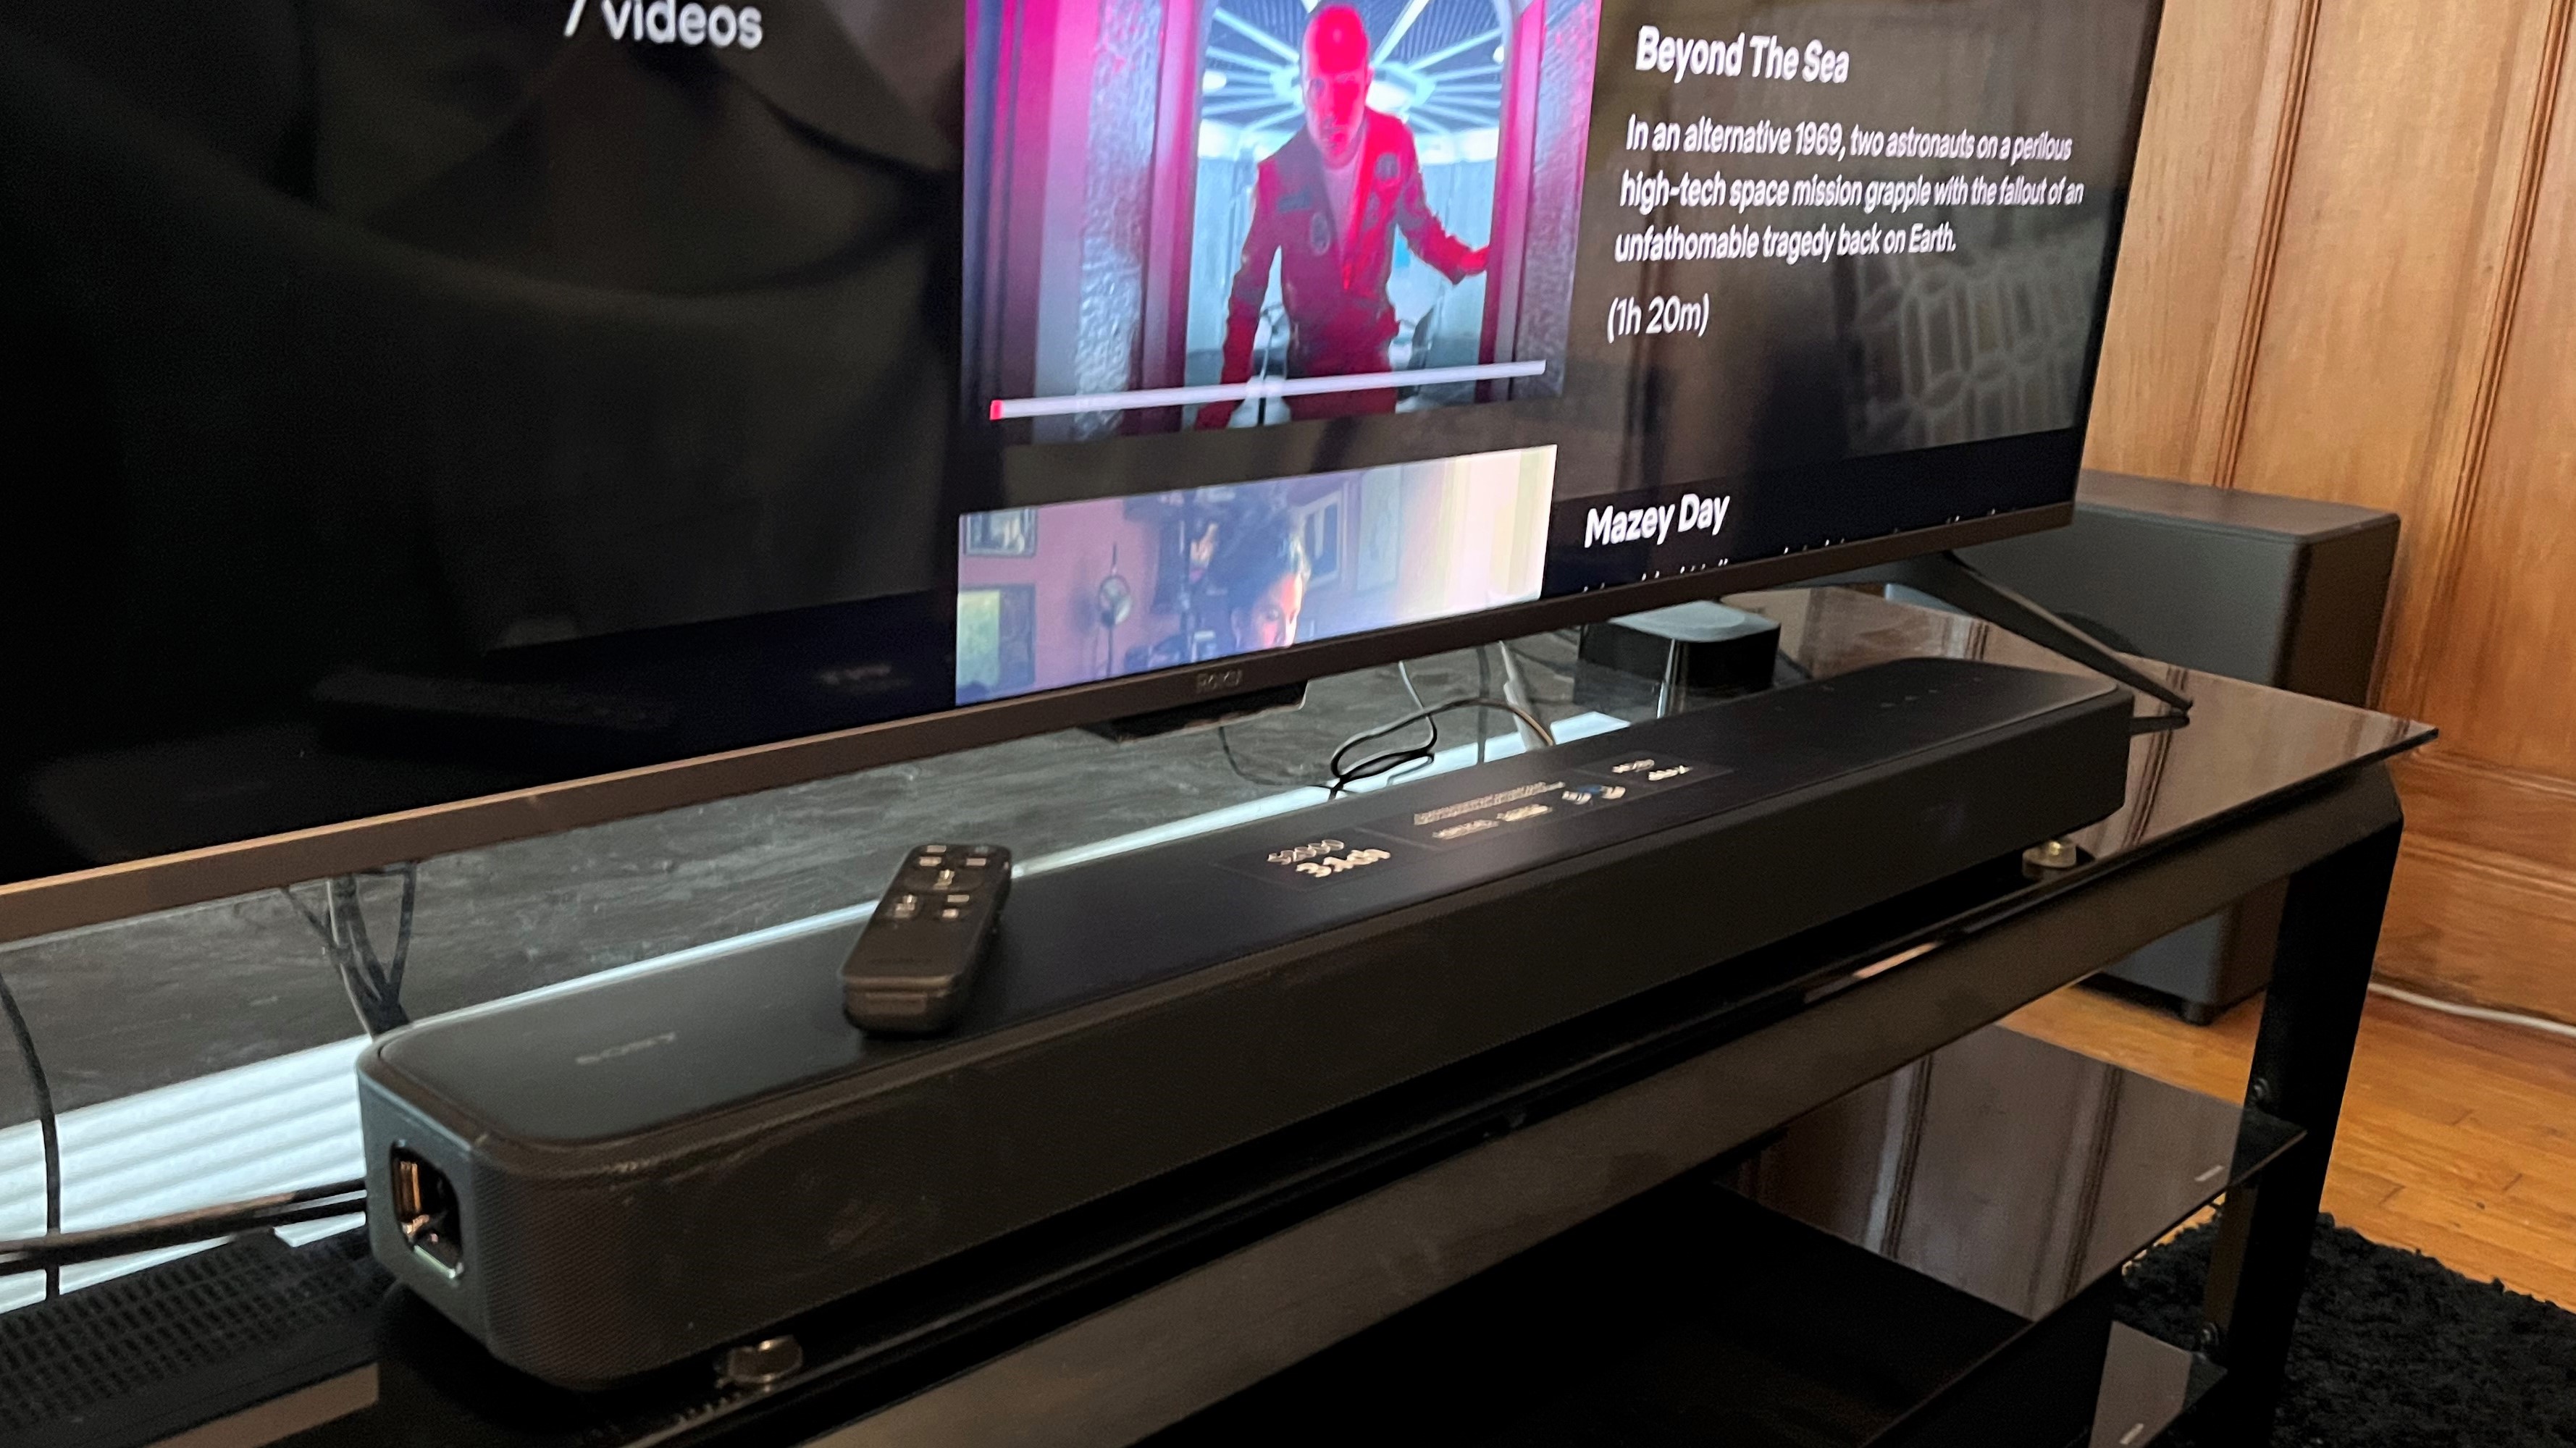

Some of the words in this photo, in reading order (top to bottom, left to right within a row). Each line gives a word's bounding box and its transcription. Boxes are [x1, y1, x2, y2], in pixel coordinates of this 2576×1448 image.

[601, 0, 763, 49] videos
[1635, 25, 1745, 83] Beyond
[1750, 35, 1799, 79] The
[1803, 40, 1850, 84] Sea
[1627, 115, 1650, 151] In
[1652, 123, 1680, 151] an
[1683, 117, 1792, 153] alternative
[1795, 124, 1846, 161] 1969,
[1850, 125, 1883, 156] two
[1884, 129, 1974, 159] astronauts
[1976, 135, 1997, 159] on
[1999, 136, 2010, 159] a
[2010, 131, 2072, 167] perilous
[1619, 170, 1725, 214] high-tech
[1729, 180, 1789, 213] space
[1792, 174, 1861, 207] mission
[1864, 175, 1930, 214] grapple
[1933, 174, 1968, 206] with
[1971, 177, 1996, 206] the
[1998, 174, 2046, 206] fallout
[2048, 175, 2065, 204] of
[2065, 180, 2084, 204] an
[1615, 224, 1760, 262] unfathomable
[1763, 225, 1836, 264] tragedy
[1837, 223, 1881, 255] back
[1883, 226, 1906, 253] on
[1908, 222, 1956, 253] Earth.
[1607, 297, 1643, 343] (1h
[1645, 292, 1710, 337] 20m)
[1584, 503, 1675, 547] Mazey
[1678, 493, 1730, 536] Day
